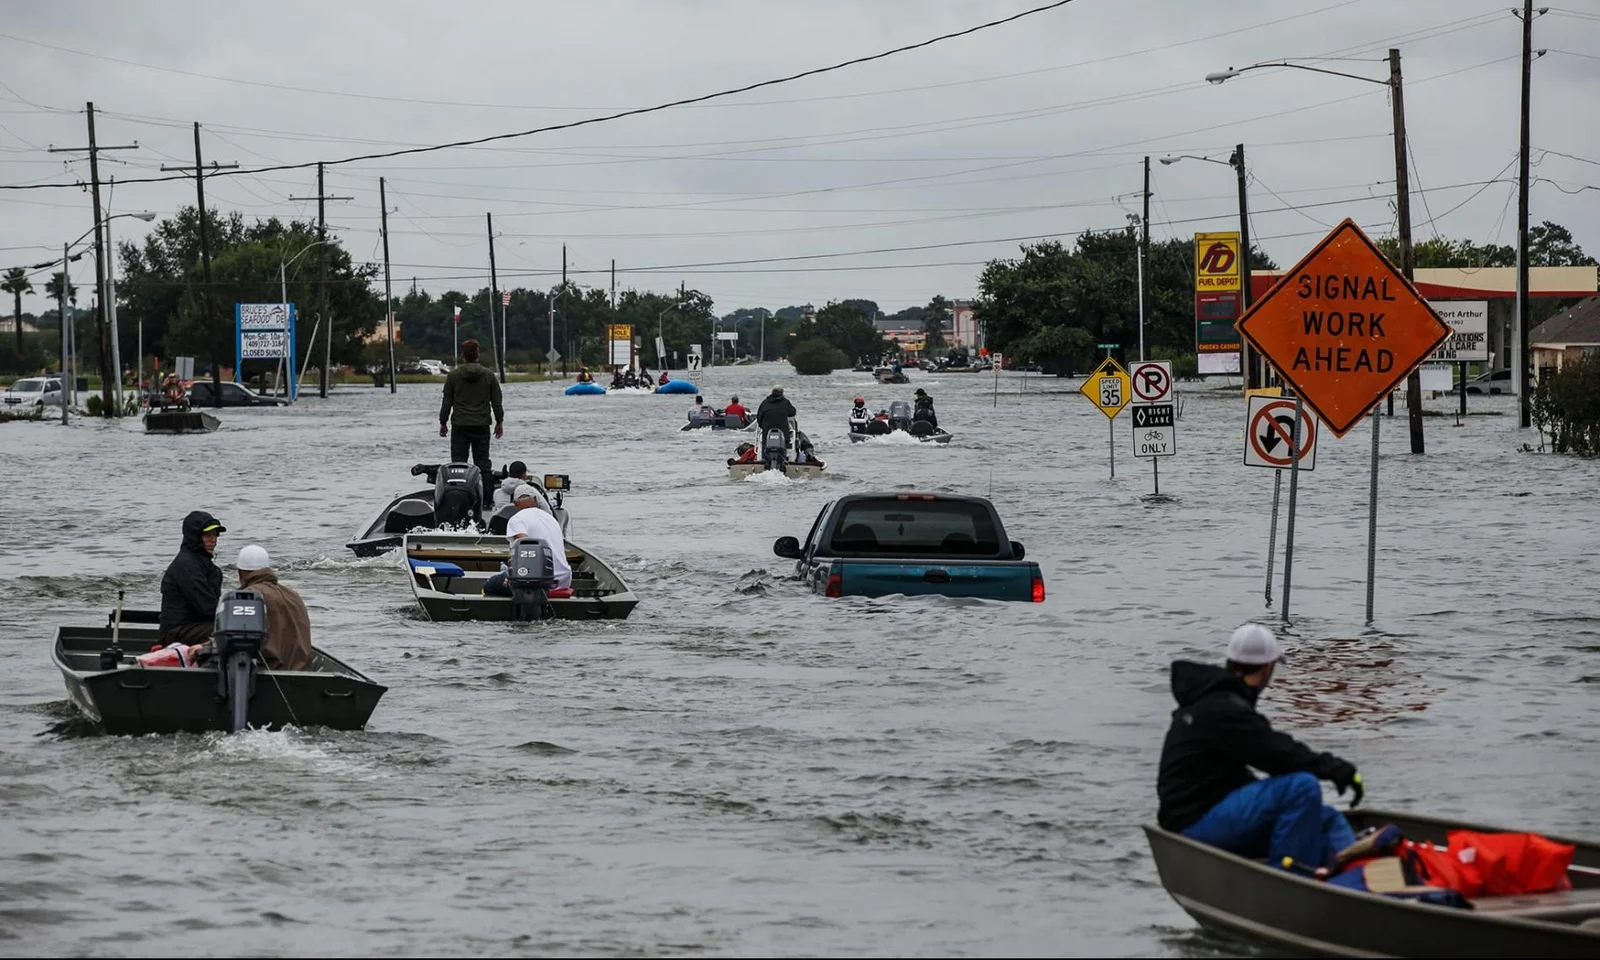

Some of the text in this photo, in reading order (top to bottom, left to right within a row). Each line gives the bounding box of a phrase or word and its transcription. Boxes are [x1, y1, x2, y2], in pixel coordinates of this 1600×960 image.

[1198, 277, 1239, 286] FUEL DEPOT
[1297, 274, 1397, 302] SIGNAL
[241, 314, 271, 324] SEAFOOD
[1302, 310, 1386, 338] WORK
[1291, 346, 1394, 374] AHEAD
[1102, 390, 1120, 406] 35
[1148, 407, 1171, 415] RIGHT
[1149, 416, 1170, 424] LANE
[1141, 443, 1168, 454] ONLY
[232, 606, 256, 616] 25
